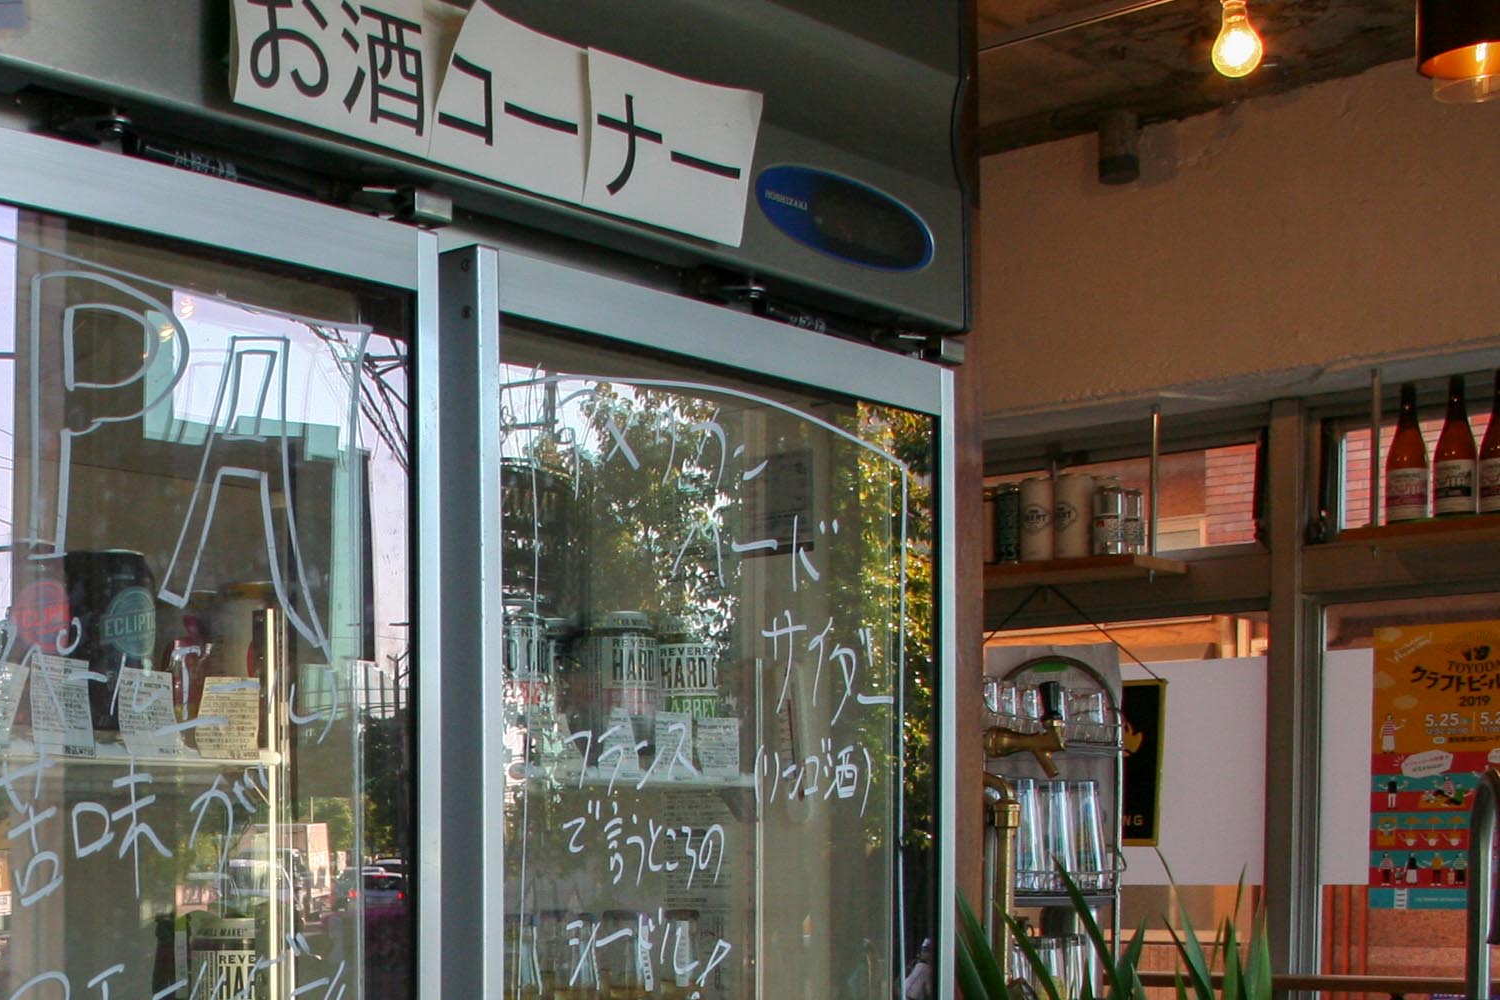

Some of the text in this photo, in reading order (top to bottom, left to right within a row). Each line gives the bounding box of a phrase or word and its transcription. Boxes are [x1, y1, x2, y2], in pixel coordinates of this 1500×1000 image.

[248, 0, 742, 197] お酒コーナー
[672, 513, 840, 592] ハード
[761, 608, 895, 727] サイダー
[1460, 695, 1491, 708] 2019
[1425, 712, 1460, 728] 5.25
[563, 722, 700, 796] フランス
